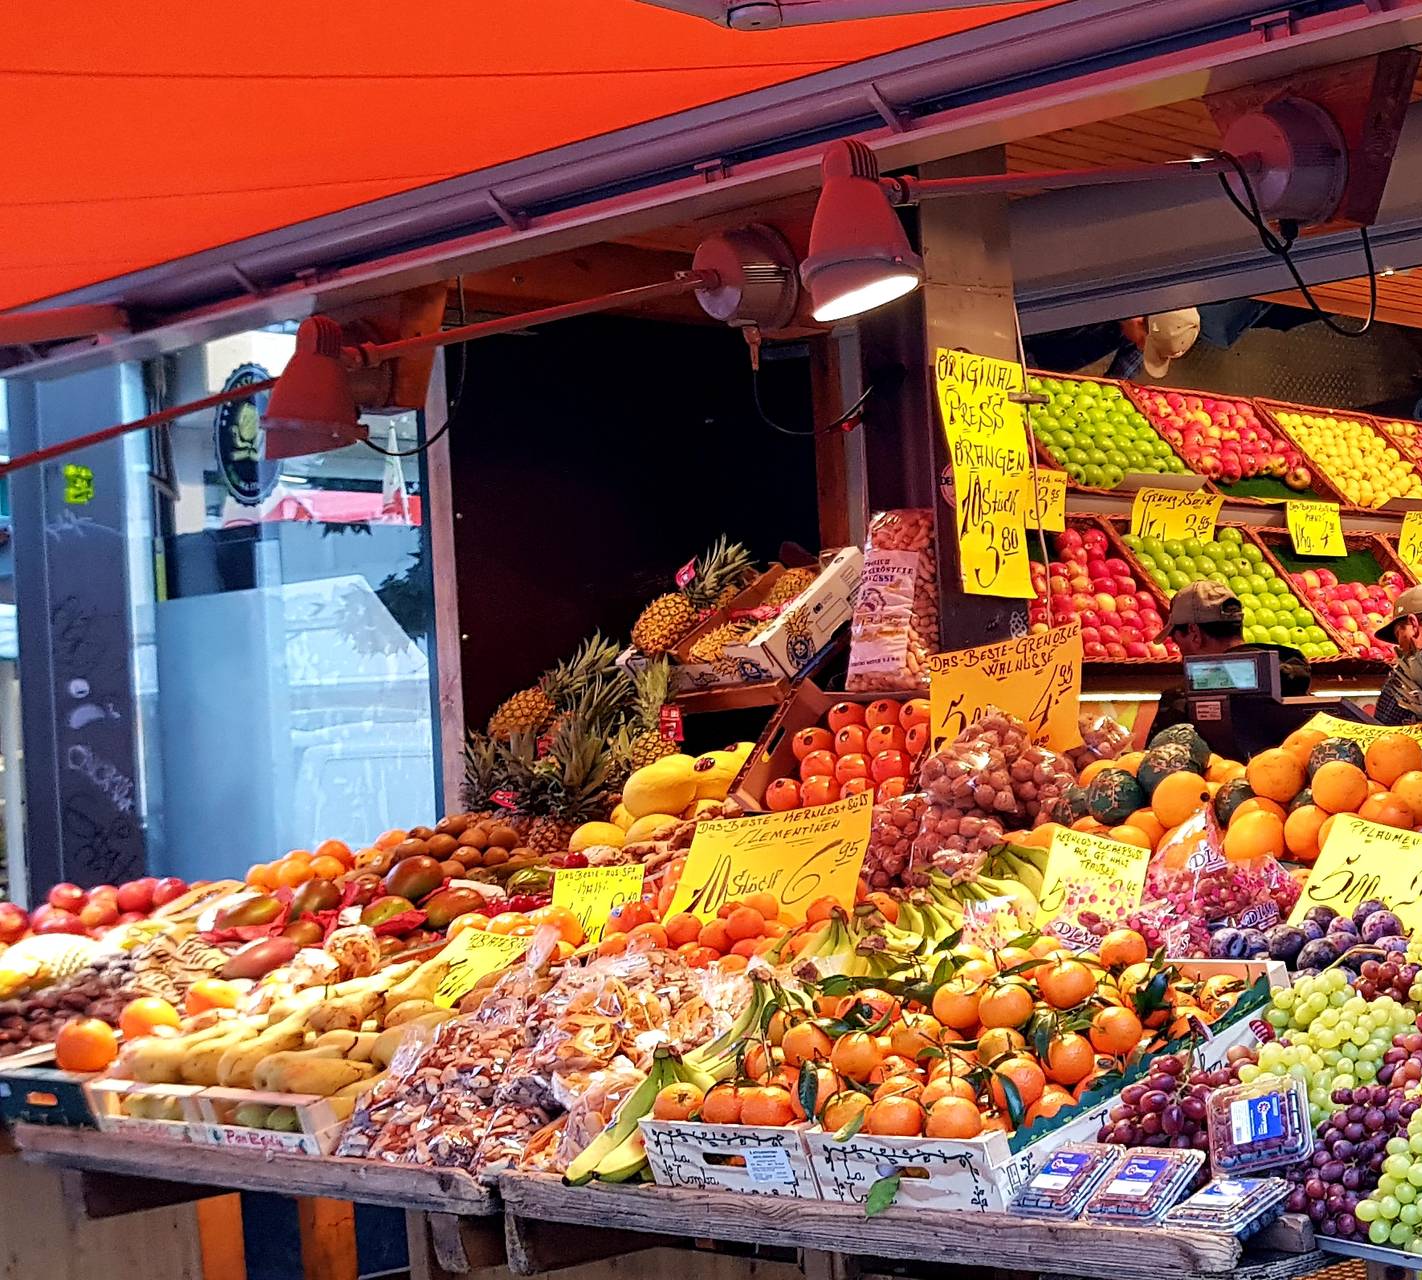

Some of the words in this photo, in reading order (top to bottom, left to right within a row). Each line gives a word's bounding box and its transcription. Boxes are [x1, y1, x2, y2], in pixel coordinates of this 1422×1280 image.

[938, 355, 1016, 394] ORIGINAL
[945, 390, 1004, 434] PRESS
[955, 436, 1025, 475] ORANGEN
[734, 820, 841, 847] CLEMENTINEN
